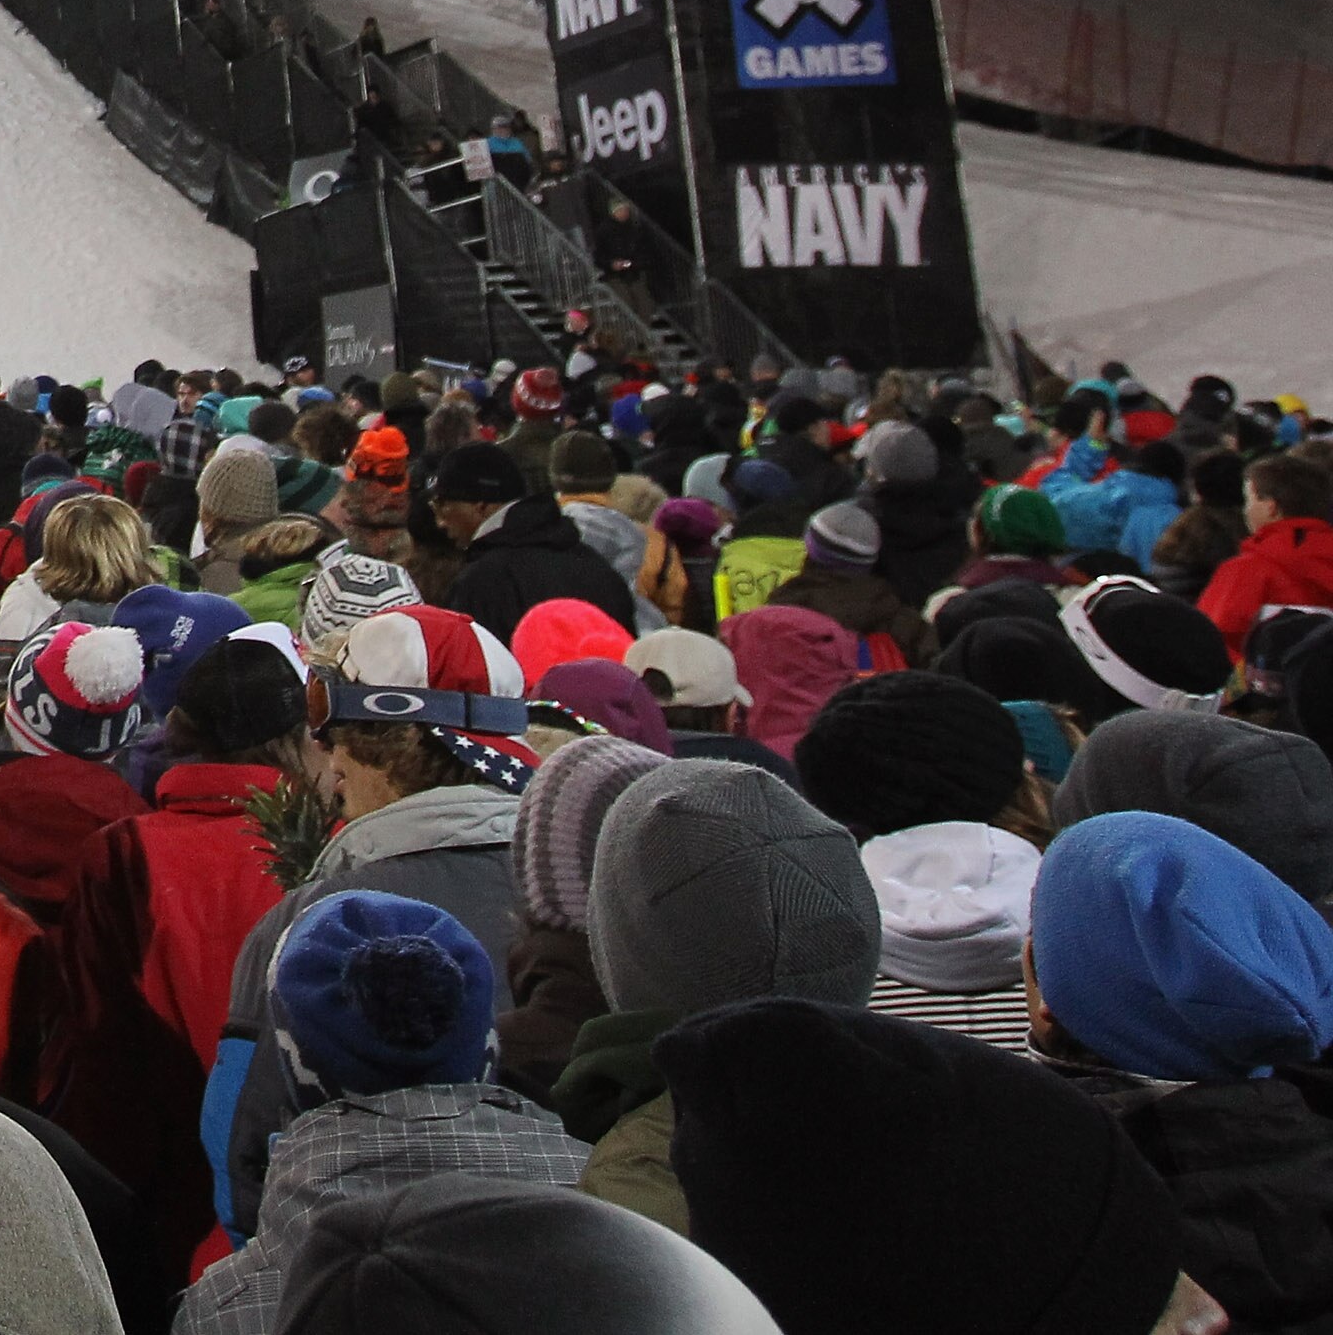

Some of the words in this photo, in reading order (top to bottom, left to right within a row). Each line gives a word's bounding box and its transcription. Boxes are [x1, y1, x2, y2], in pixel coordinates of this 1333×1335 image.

[745, 44, 887, 80] GAMES
[574, 86, 667, 163] Jeep
[738, 183, 928, 268] NAVY
